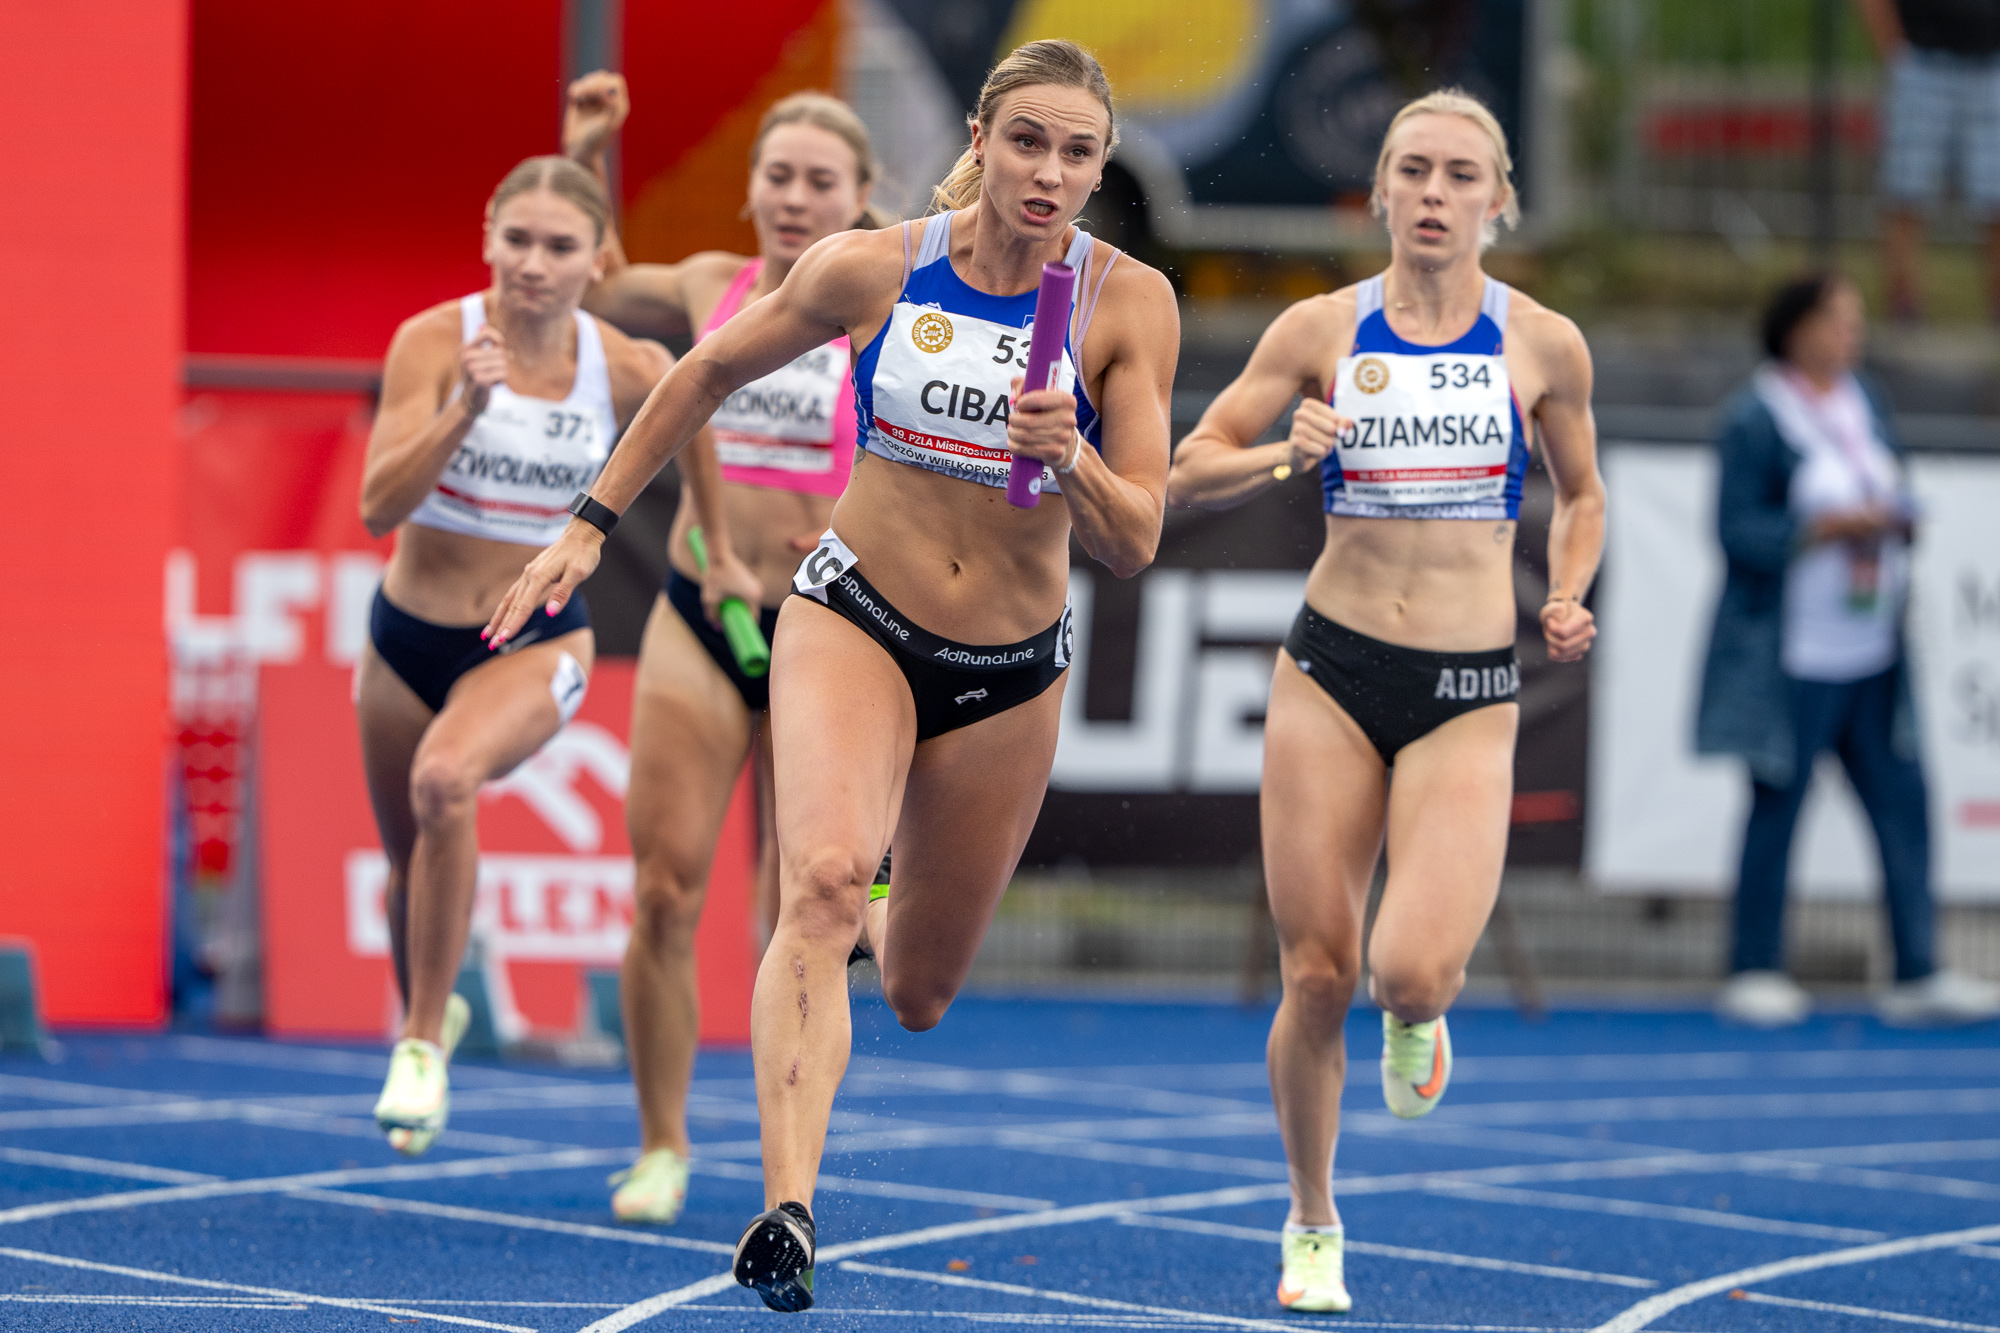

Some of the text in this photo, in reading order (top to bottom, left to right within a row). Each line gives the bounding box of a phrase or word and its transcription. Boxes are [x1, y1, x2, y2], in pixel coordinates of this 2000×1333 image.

[1430, 364, 1492, 389] 534
[909, 433, 933, 447] PZLA
[936, 439, 1000, 459] Mistrzostwa
[838, 574, 1035, 666] dRunaLine AdRunaLine
